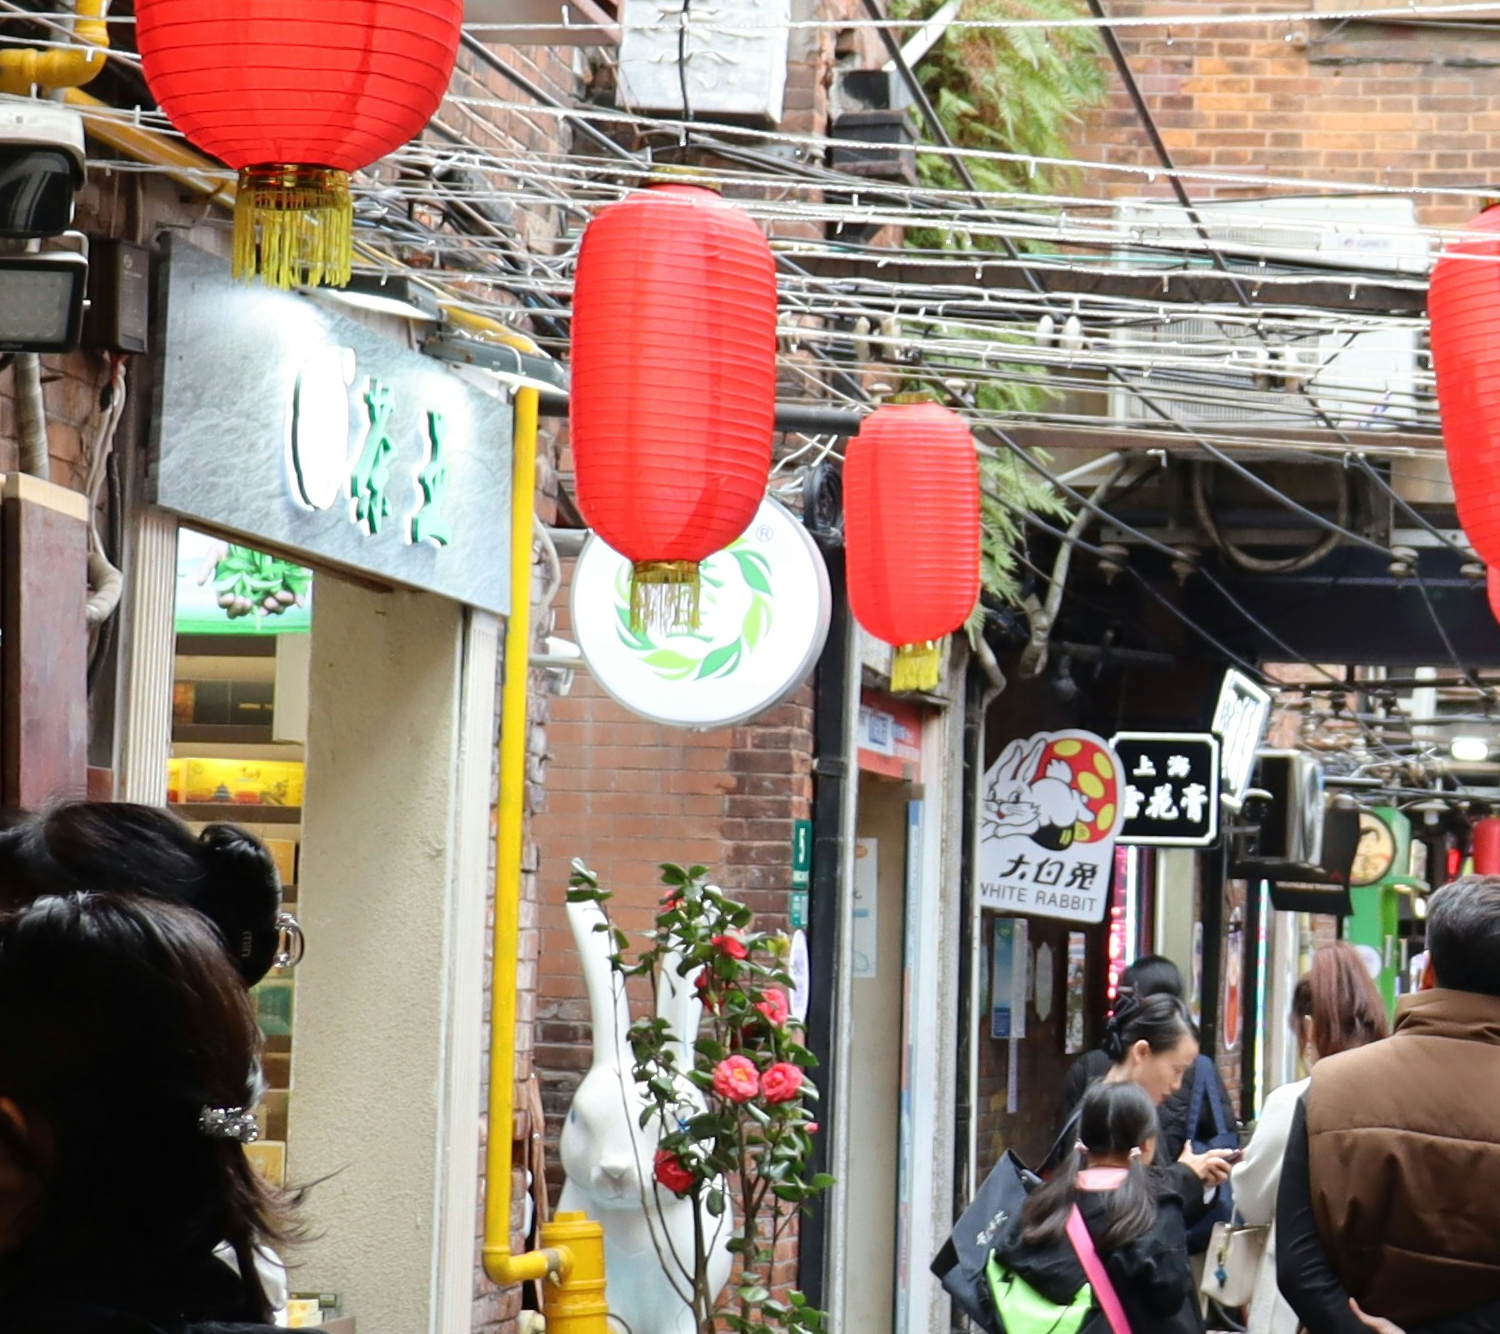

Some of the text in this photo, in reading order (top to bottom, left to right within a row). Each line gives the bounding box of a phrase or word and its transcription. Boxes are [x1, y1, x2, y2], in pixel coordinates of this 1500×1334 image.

[1133, 754, 1192, 778] 上海
[999, 853, 1099, 890] 大白兔
[1035, 890, 1097, 912] RABBIT
